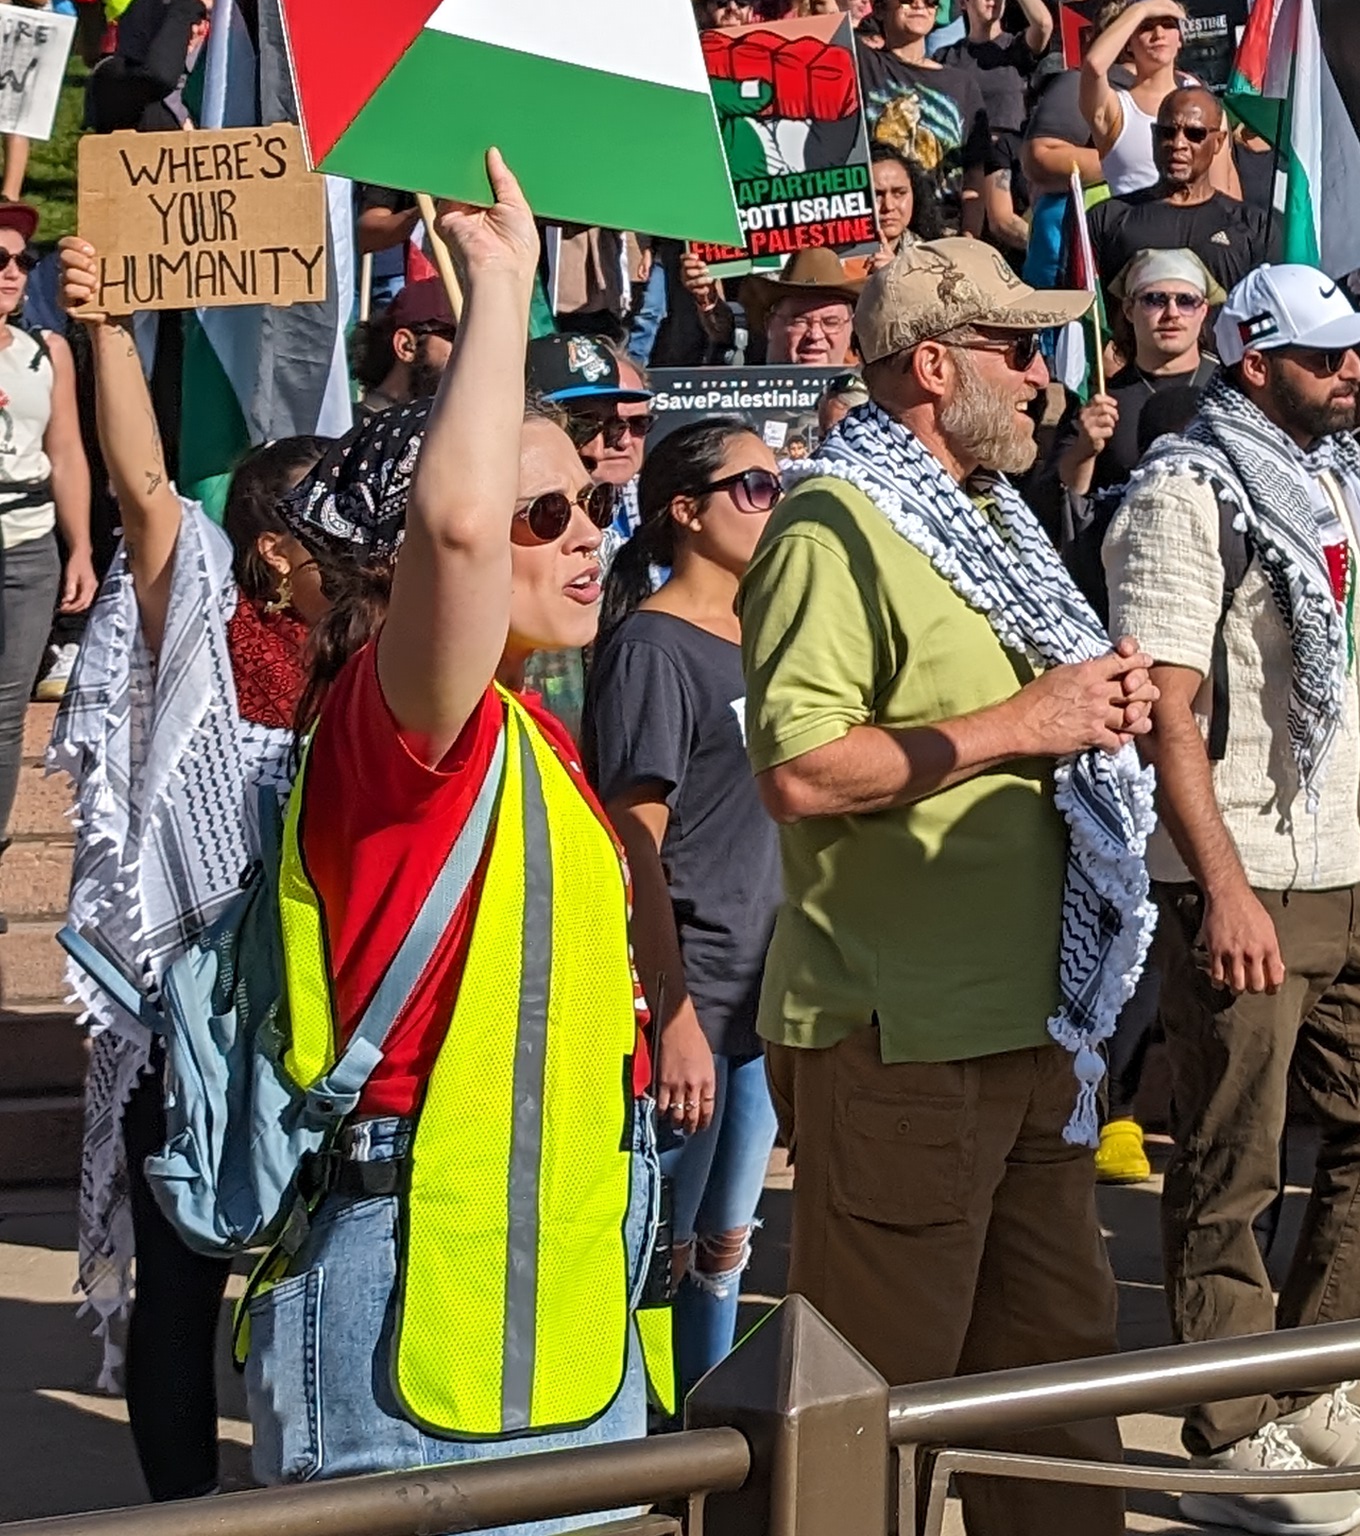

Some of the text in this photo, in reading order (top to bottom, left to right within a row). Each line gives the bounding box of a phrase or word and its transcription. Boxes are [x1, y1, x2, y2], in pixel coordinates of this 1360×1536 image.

[119, 133, 287, 186] WHERE'S
[737, 166, 868, 205] APARTHEID
[148, 189, 237, 246] YOUR
[738, 191, 872, 230] COTT ISRAEL
[752, 216, 875, 255] PALESTINE
[98, 245, 324, 306] HUMANITY
[673, 379, 793, 389] WE STAND WITH
